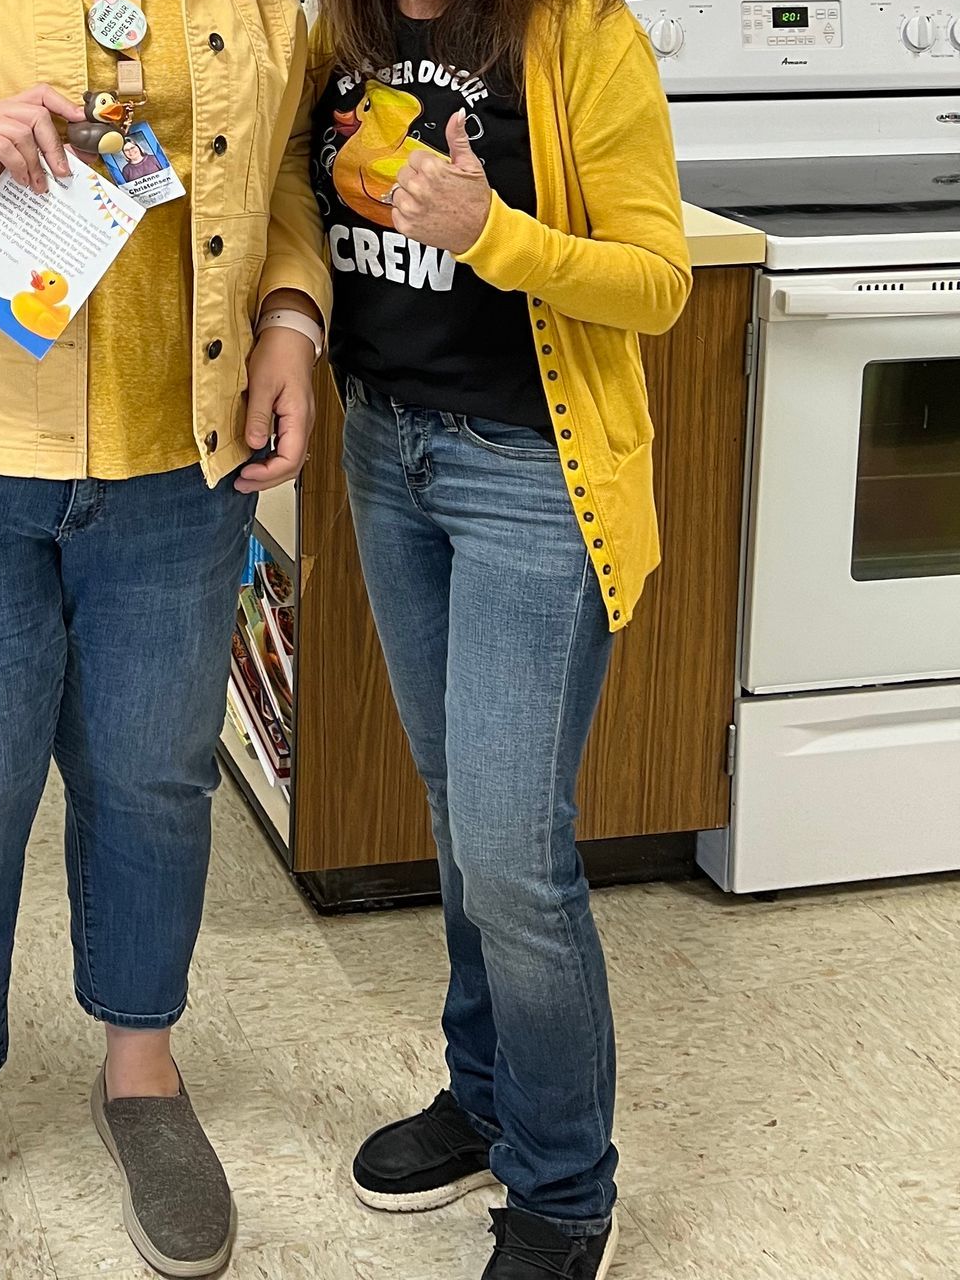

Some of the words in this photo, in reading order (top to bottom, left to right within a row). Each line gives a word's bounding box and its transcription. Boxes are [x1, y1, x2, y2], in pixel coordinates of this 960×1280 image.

[97, 5, 113, 22] WHAT
[100, 20, 116, 37] DOES
[112, 5, 129, 21] YOUR
[109, 23, 129, 44] RECIPE
[125, 10, 139, 25] SAY?
[1, 184, 20, 200] Thanks
[26, 203, 46, 219] working
[330, 224, 456, 292] CREW
